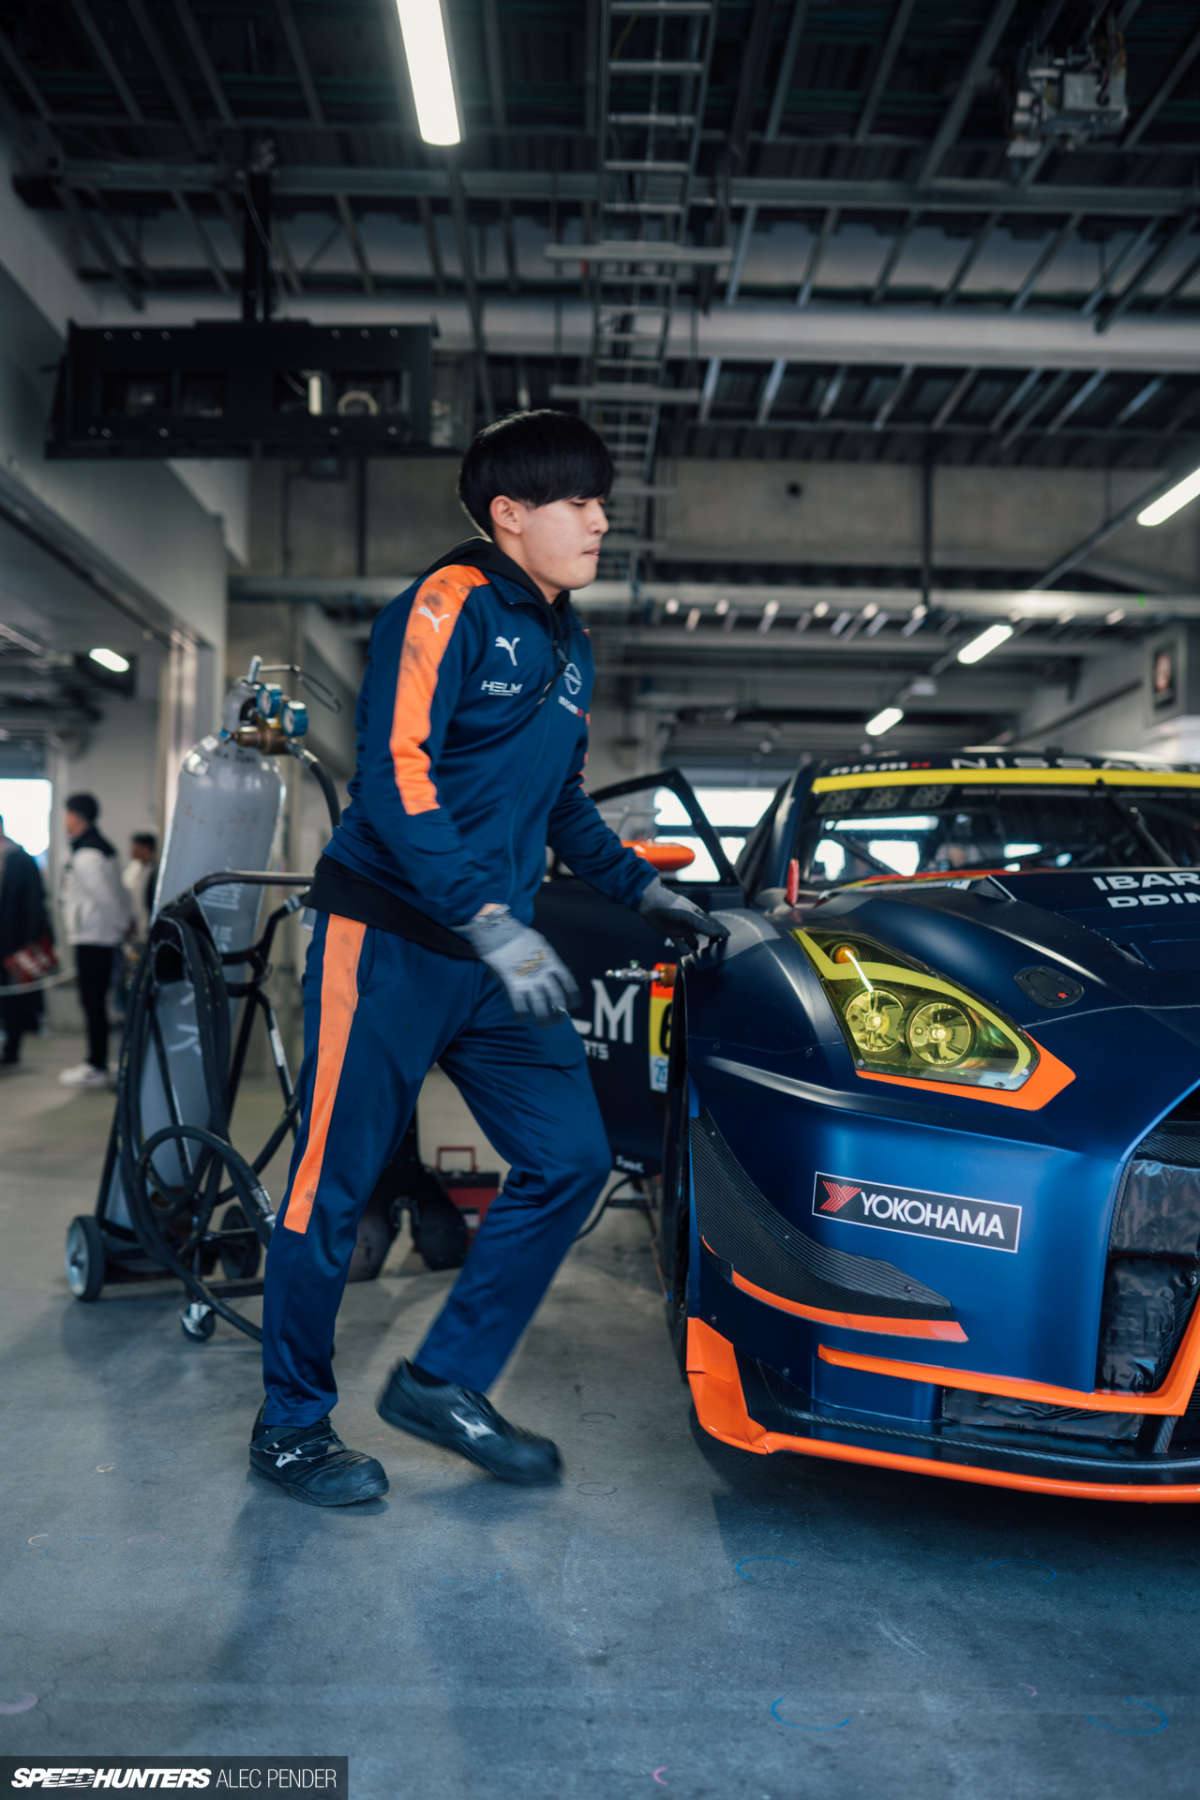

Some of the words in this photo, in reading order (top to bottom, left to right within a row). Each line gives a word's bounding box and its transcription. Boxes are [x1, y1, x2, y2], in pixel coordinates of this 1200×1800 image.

[481, 680, 524, 694] HELM
[1092, 872, 1200, 891] IBAR
[860, 1191, 1005, 1240] YOKOHAMA
